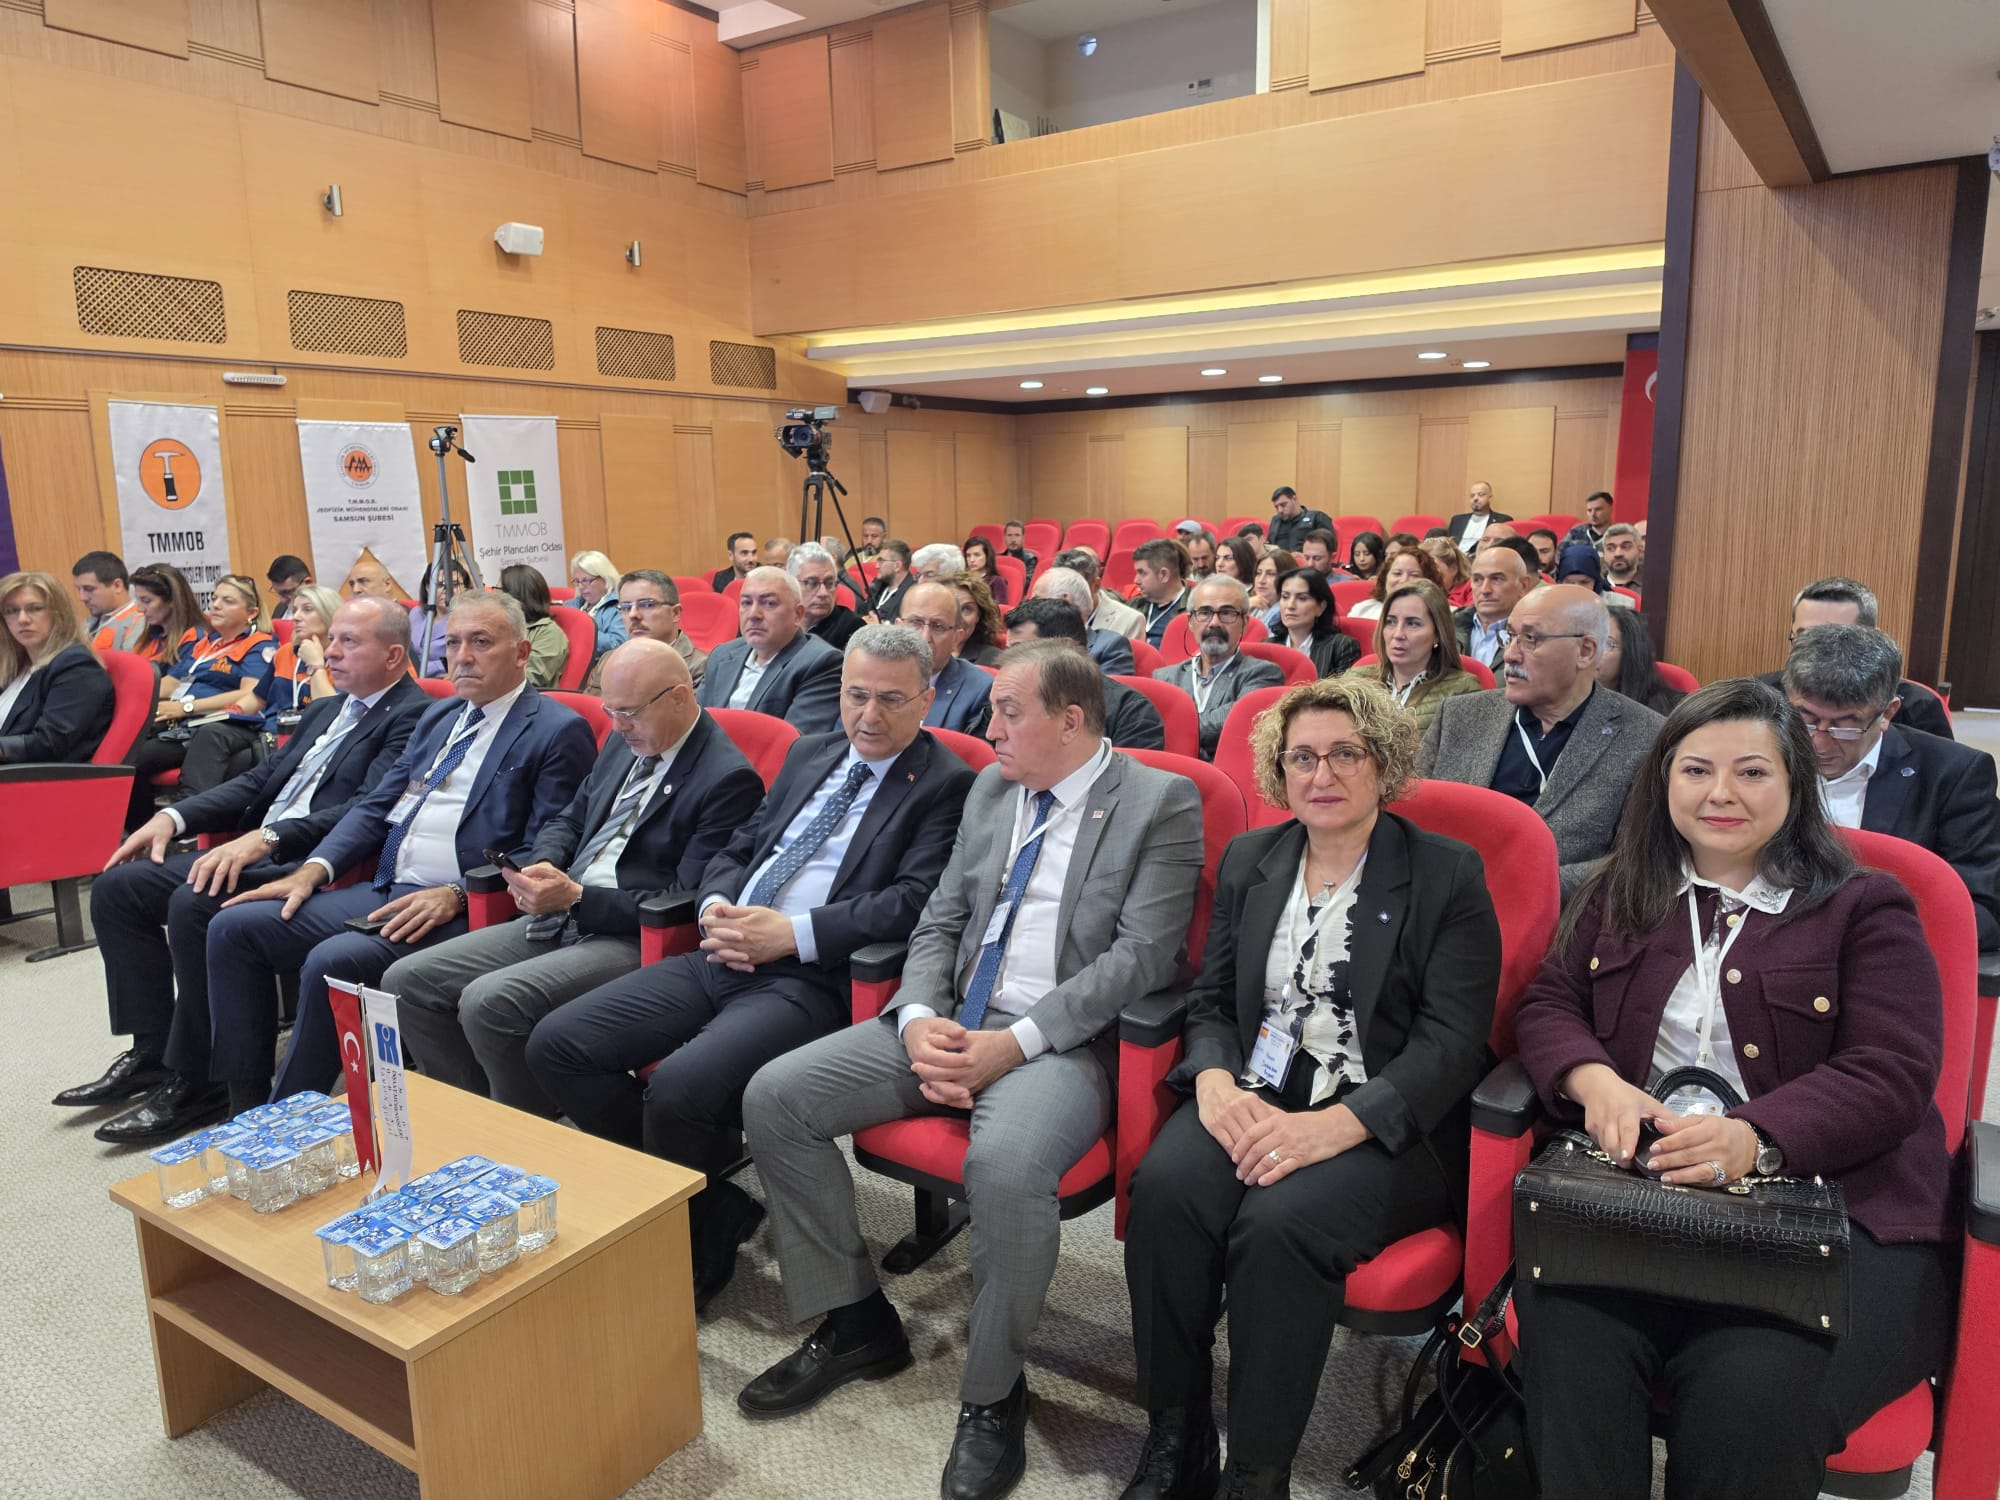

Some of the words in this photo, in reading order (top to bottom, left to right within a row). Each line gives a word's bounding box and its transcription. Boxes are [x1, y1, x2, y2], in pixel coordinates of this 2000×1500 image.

[367, 514, 394, 523] ŞUBESİ
[495, 522, 548, 539] TMMOB
[147, 531, 205, 553] TMMOB
[479, 546, 501, 560] Şehir
[541, 542, 563, 552] Odası
